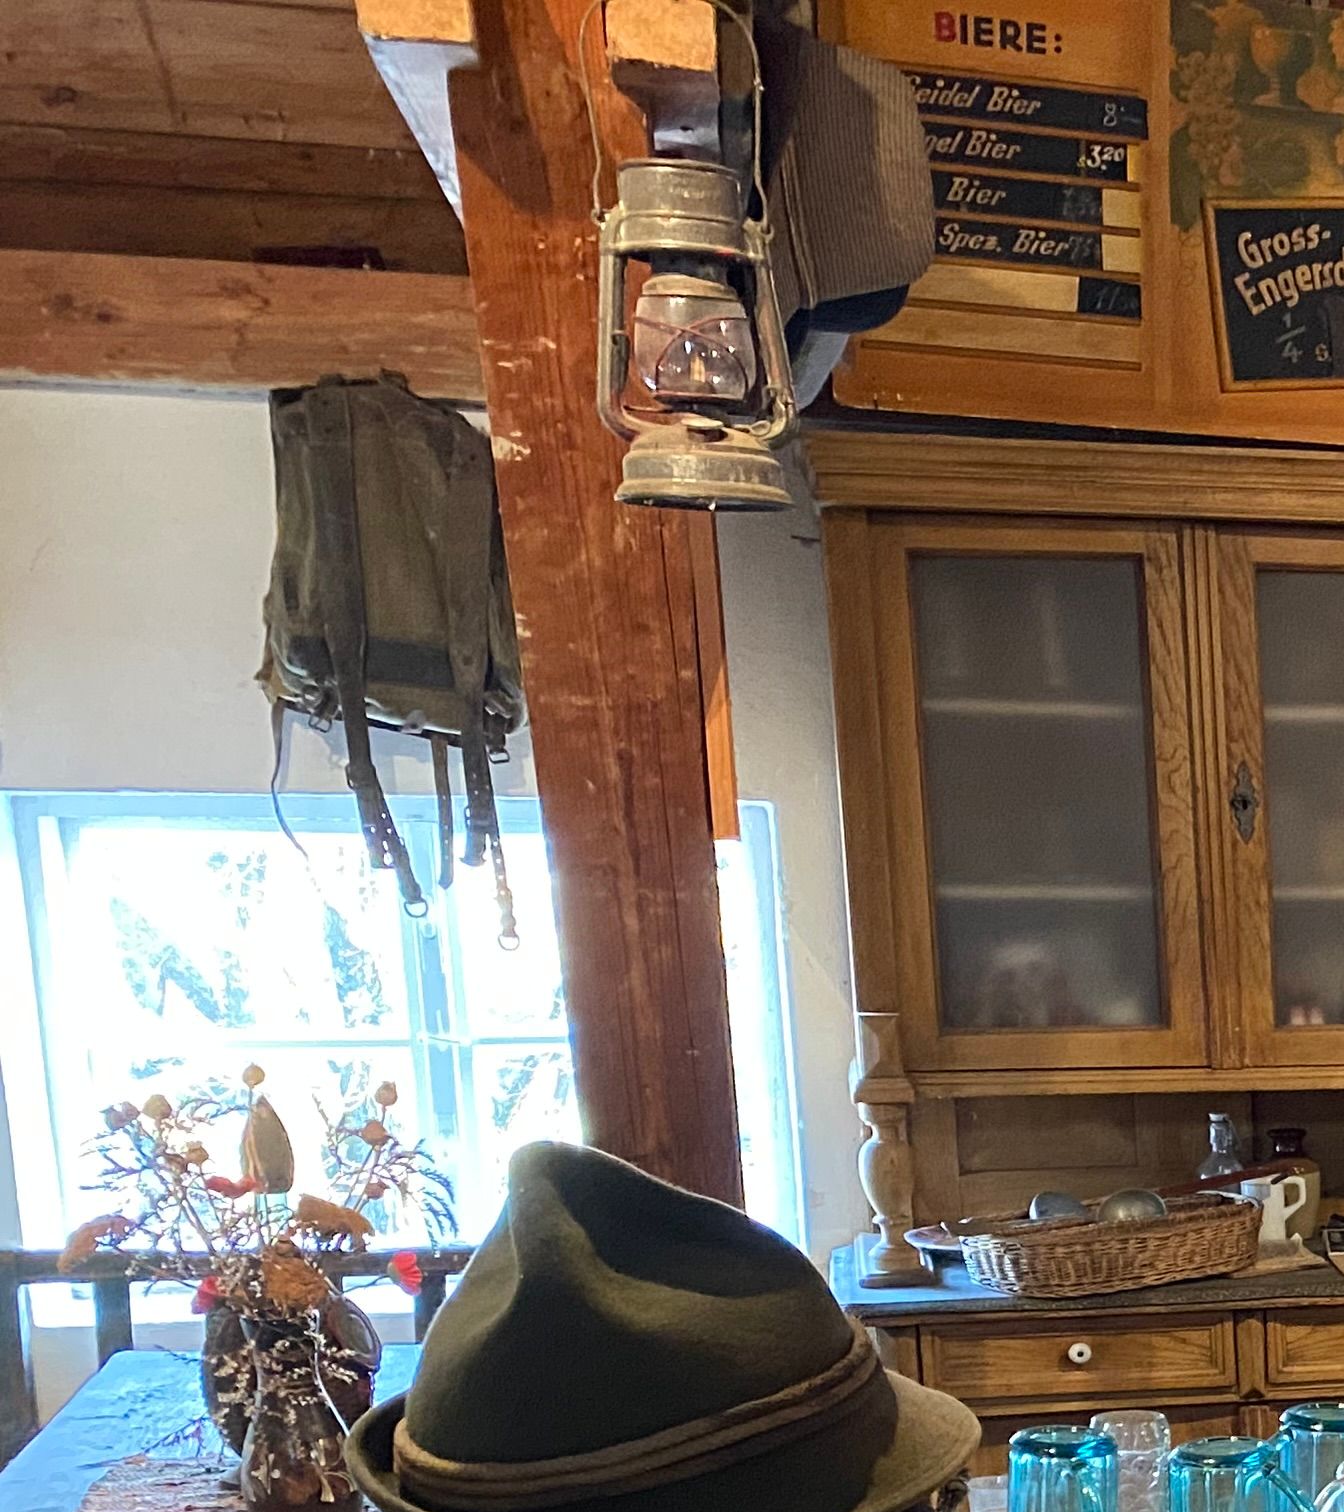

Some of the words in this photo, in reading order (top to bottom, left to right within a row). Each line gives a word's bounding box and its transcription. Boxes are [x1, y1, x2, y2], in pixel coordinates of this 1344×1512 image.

[934, 12, 1062, 54] BIERE:
[987, 86, 1041, 115] Bier
[965, 131, 1021, 160] Bier
[947, 177, 1007, 206] Bier
[939, 223, 1002, 253] Spez.
[1013, 229, 1070, 257] Bier
